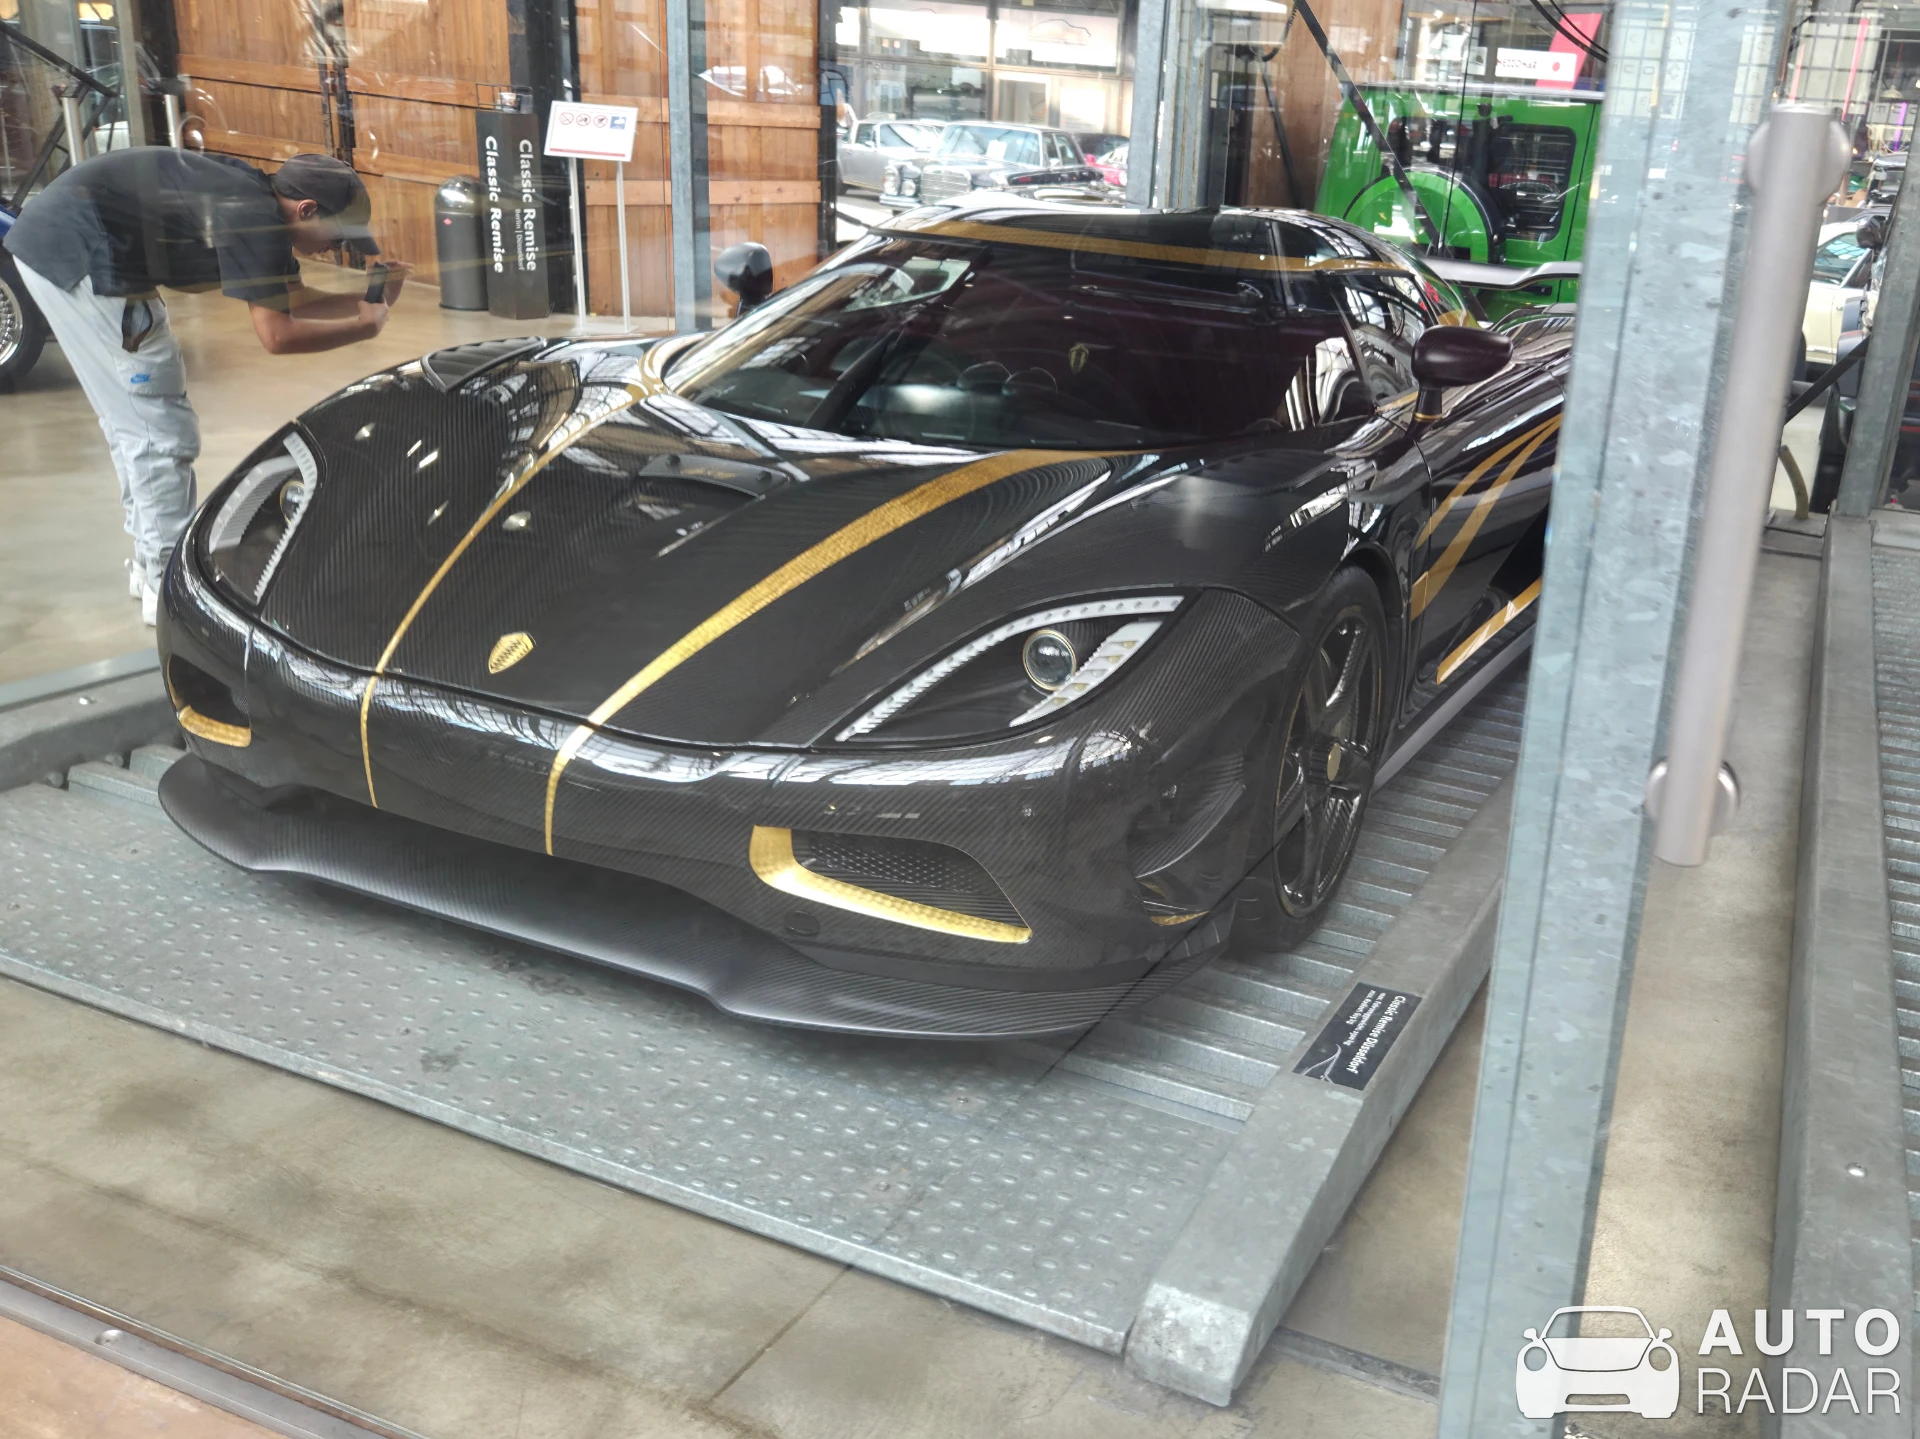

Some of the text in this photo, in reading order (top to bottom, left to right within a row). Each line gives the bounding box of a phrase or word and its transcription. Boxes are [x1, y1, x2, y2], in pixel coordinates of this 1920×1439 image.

[485, 136, 505, 273] Classic Remise
[516, 235, 525, 270] Düsseldorf
[519, 139, 539, 271] Classic Remise
[1346, 995, 1406, 1074] Classic Remise Düsseldorf
